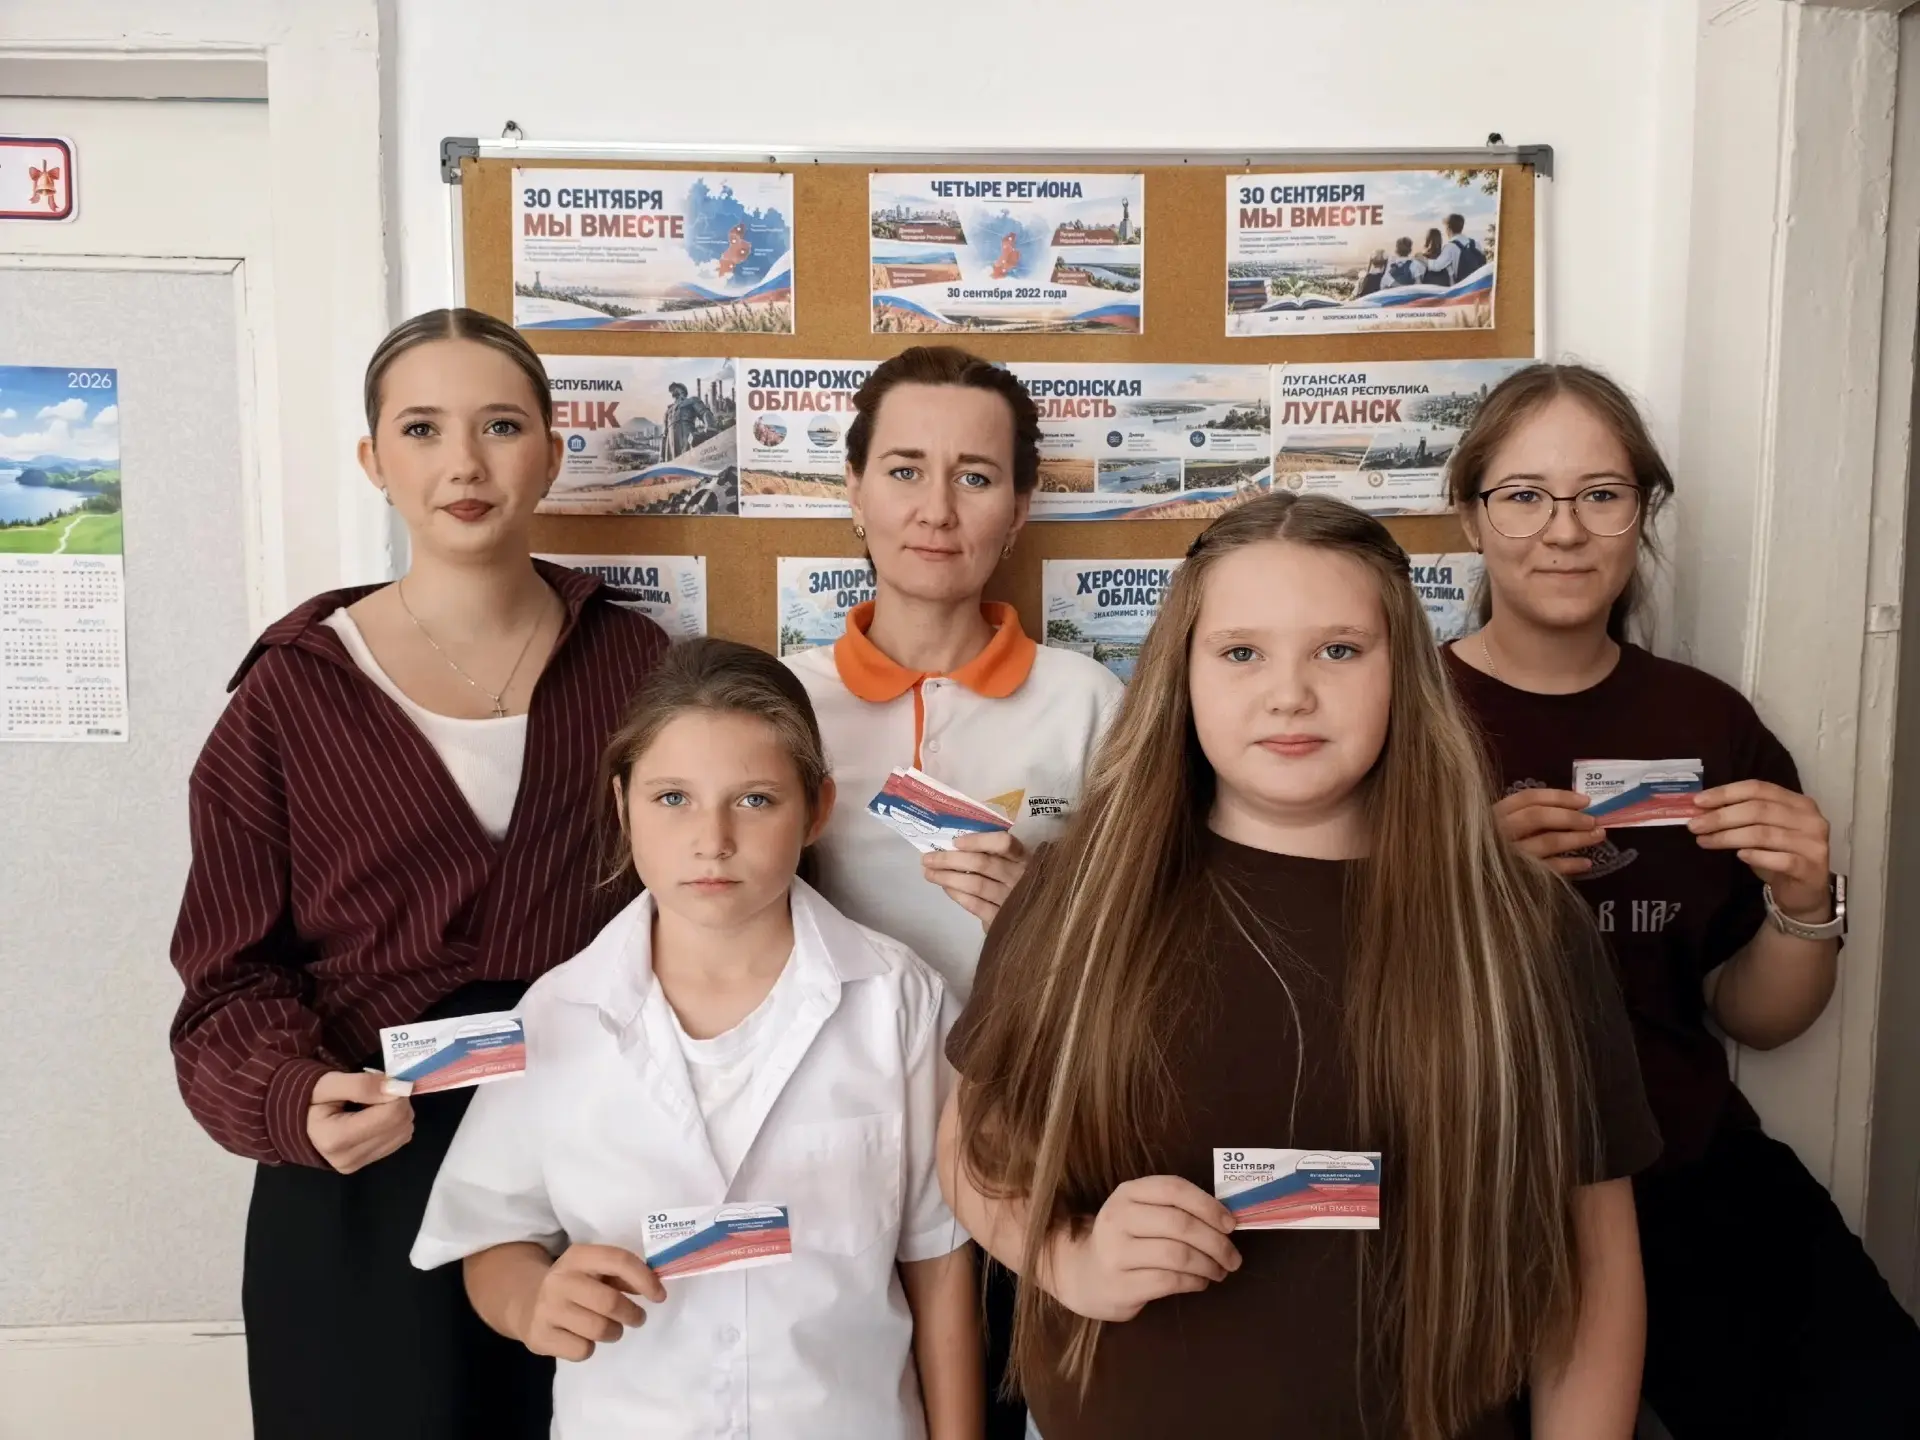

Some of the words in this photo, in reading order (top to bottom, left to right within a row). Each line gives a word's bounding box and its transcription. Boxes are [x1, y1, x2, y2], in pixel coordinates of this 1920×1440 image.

[931, 181, 1001, 198] ЧЕТЫРЕ
[1006, 180, 1083, 198] РЕГИОНА
[1239, 187, 1265, 205] 30
[1270, 184, 1365, 204] СЕНТЯБРЯ
[523, 188, 551, 208] 30
[557, 189, 663, 210] СЕНТЯБРЯ
[1239, 207, 1282, 228] МЫ
[1290, 205, 1384, 227] ВМЕСТЕ
[523, 213, 572, 238] МЫ
[580, 214, 685, 239] ВМЕСТЕ
[947, 287, 960, 298] 30
[962, 287, 1013, 300] сентября
[1015, 288, 1040, 298] 2022
[1043, 290, 1067, 299] года
[67, 372, 112, 389] 2026
[549, 379, 623, 392] ЕСПУБЛИКА
[1282, 373, 1367, 386] ЛУГАНСКАЯ
[1282, 386, 1348, 397] НАРОДНАЯ
[1351, 384, 1430, 396] РЕСПУБЛИКА
[551, 401, 621, 430] ЕЦК
[1034, 398, 1117, 419] БЛАСТЬ
[1281, 399, 1403, 425] ЛУГАНСК
[809, 569, 877, 594] ЗАПОРО
[1076, 568, 1170, 596] ХЕРСОНСК
[1415, 586, 1465, 601] УБЛИКА
[1585, 772, 1603, 781] 30
[1030, 806, 1062, 816] ДЕТСТВА
[391, 1032, 409, 1042] 30
[391, 1037, 437, 1049] СЕНТЯБРЯ
[1223, 1151, 1245, 1162] 30
[647, 1213, 668, 1223] 30
[648, 1219, 696, 1230] СЕНТЯБРЯ
